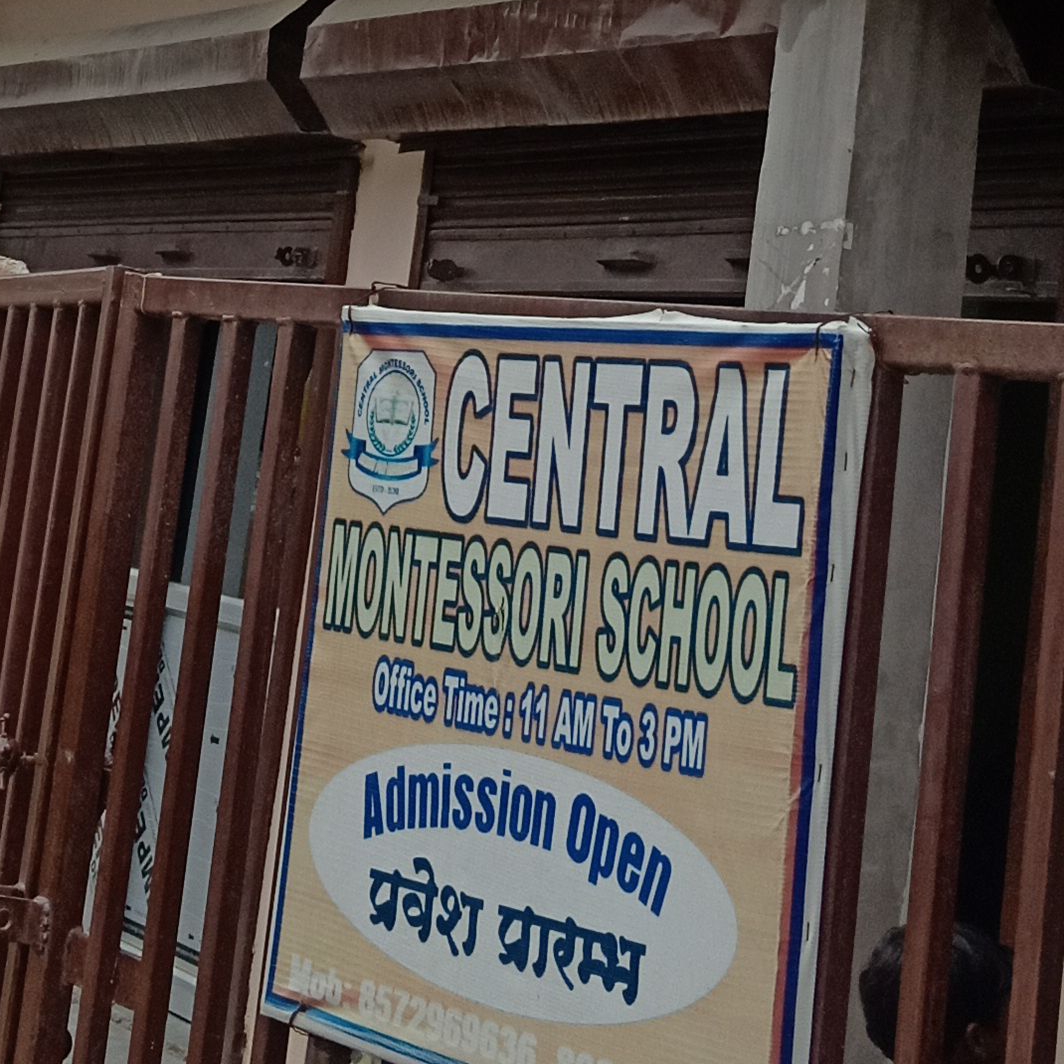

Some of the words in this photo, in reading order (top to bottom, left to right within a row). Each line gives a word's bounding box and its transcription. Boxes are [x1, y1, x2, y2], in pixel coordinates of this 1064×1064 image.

[358, 372, 377, 417] CENTRAL
[379, 358, 417, 380] MONTESSORI
[417, 379, 430, 425] SCHOOL
[441, 350, 805, 557] CENTRAL
[322, 517, 587, 673] MONTESSORI
[596, 551, 798, 709] SCHOOL
[372, 655, 437, 723] Office
[521, 682, 549, 747] 11
[552, 689, 597, 756] AM
[602, 697, 634, 763] To
[638, 703, 658, 767] 3
[661, 707, 708, 778] PM
[363, 762, 556, 851] Admission
[566, 793, 672, 917] Open
[369, 857, 484, 957] प्रवेश
[498, 904, 646, 1006] प्रारम्भ
[359, 979, 537, 1064] 8572969636
